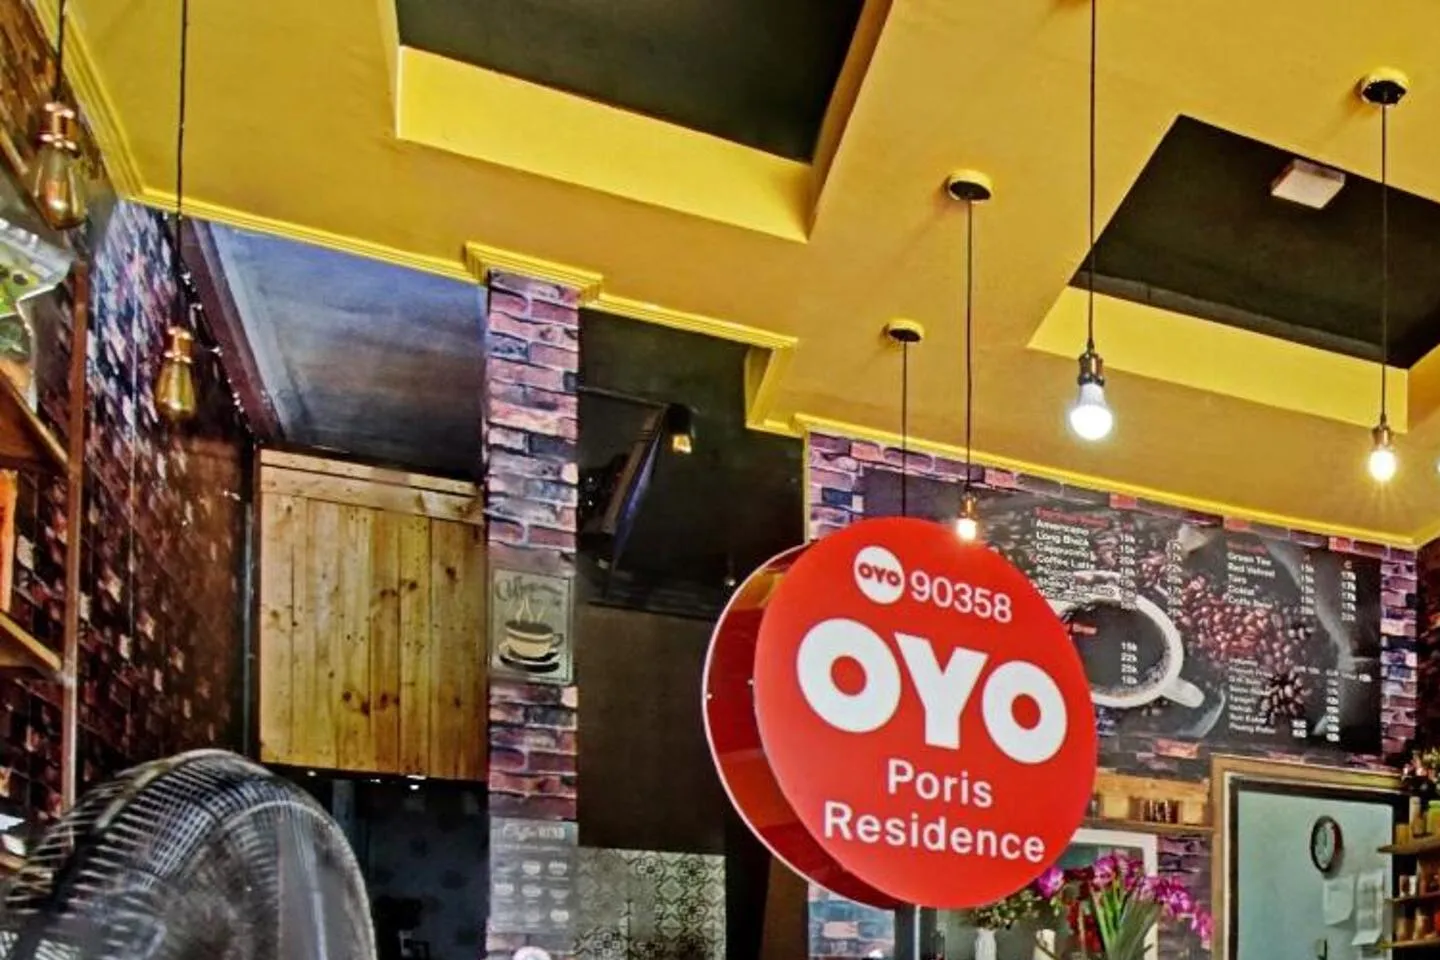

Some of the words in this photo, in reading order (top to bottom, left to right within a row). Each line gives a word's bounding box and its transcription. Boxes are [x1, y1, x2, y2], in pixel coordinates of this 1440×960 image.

[857, 561, 901, 587] OYO
[909, 571, 1013, 624] 90358
[796, 618, 1068, 765] OYO
[888, 759, 993, 807] Poris
[823, 801, 1046, 863] Residence
